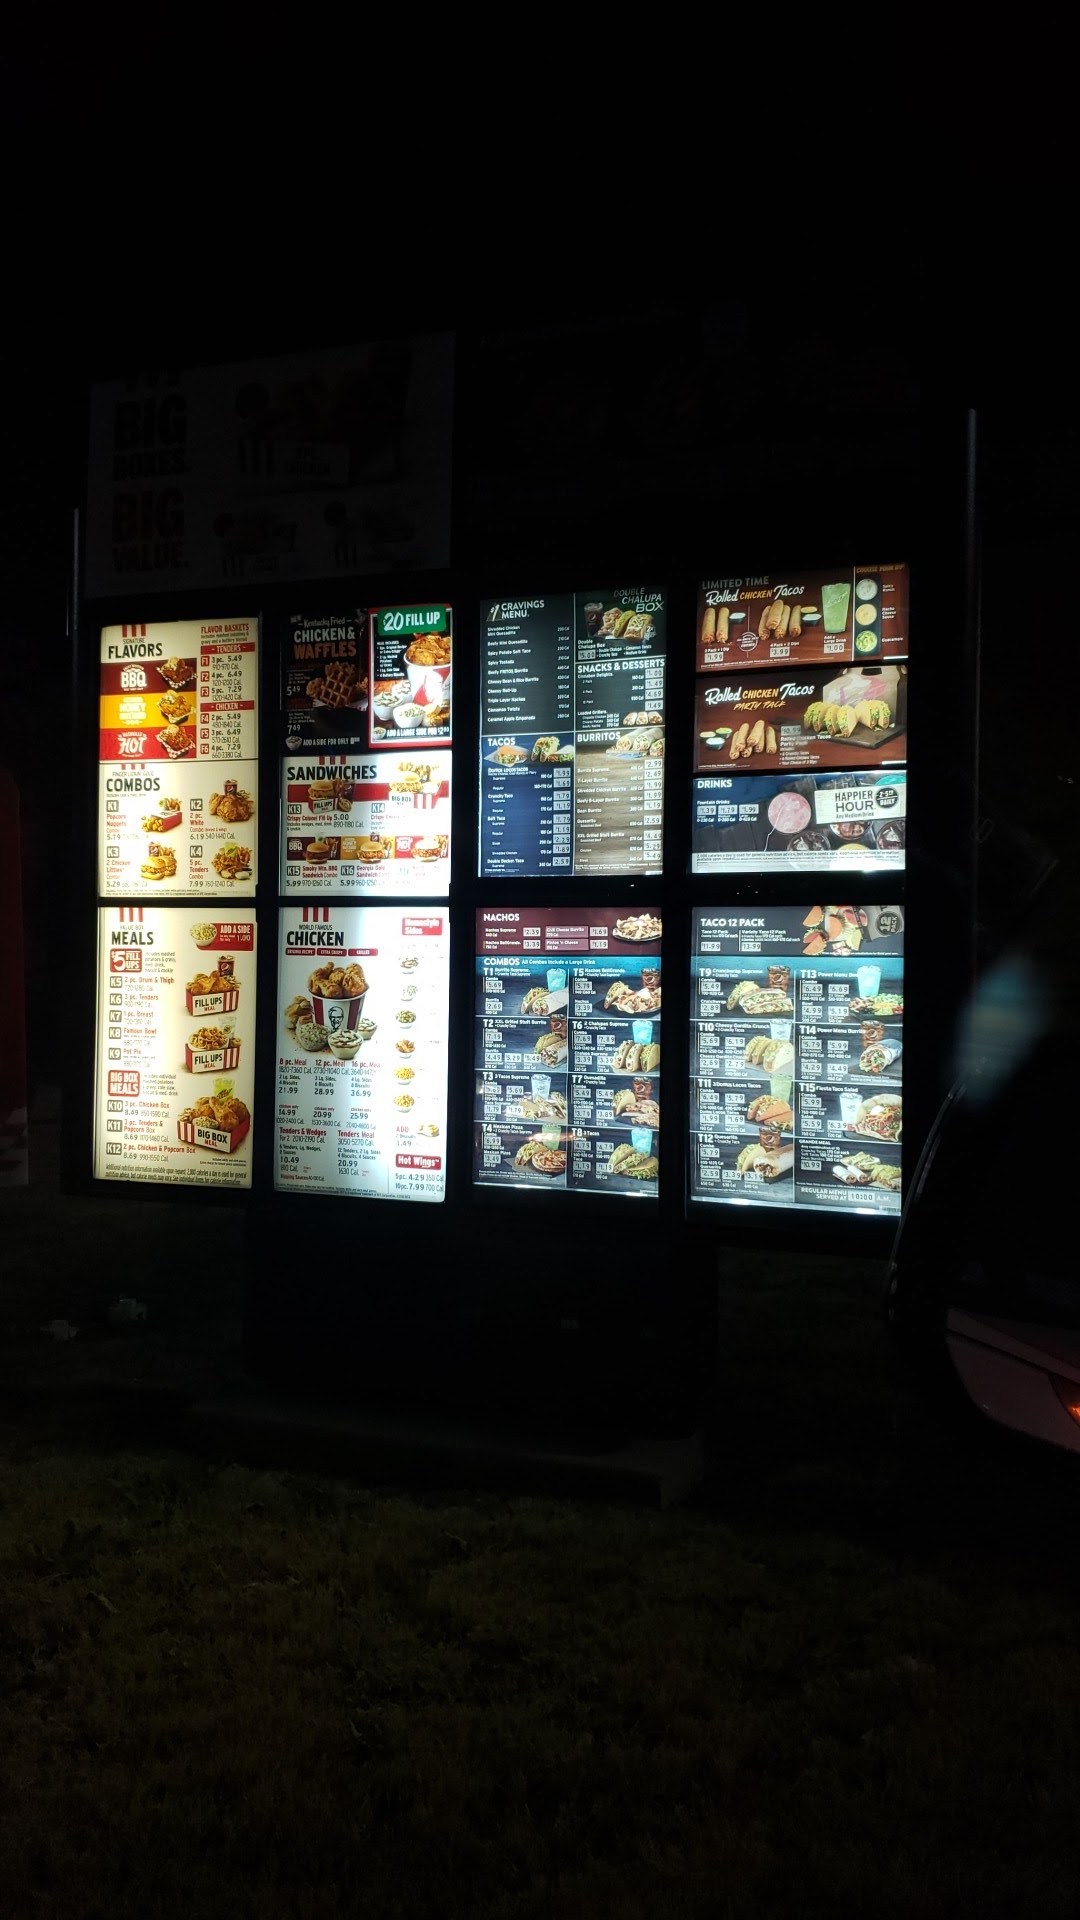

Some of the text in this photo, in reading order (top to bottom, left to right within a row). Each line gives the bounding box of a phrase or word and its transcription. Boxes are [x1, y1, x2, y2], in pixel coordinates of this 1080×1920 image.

[112, 393, 189, 452] BIG
[701, 576, 770, 590] LIMITED TIME
[613, 588, 645, 598] DOUBLE
[705, 584, 805, 606] Rolled CHICKEN Tacos
[621, 593, 662, 605] CHALUPA
[501, 600, 545, 611] CRAVINGS
[635, 601, 664, 613] BOX
[303, 617, 345, 629] Kentucky Fried
[405, 613, 424, 627] FILL
[428, 611, 441, 625] UP
[201, 623, 249, 634] FLAVOR BASKETS
[294, 626, 356, 643] CHICKEN &
[108, 643, 163, 659] FLAVORS
[293, 643, 357, 660] WAFFLES
[578, 664, 612, 673] SNACKS
[622, 658, 665, 670] DESSERTS
[120, 671, 148, 688] BBQ
[704, 682, 815, 705] Rolled CHICKEN Tacos
[733, 702, 760, 711] PARTY
[201, 715, 208, 723] F4
[488, 738, 516, 747] TACOS
[577, 731, 621, 743] BURRITOS
[287, 765, 378, 781] SANDWICHES
[106, 777, 161, 792] COMBOS
[697, 779, 732, 789] DRINKS
[834, 790, 873, 802] HAPPIER
[191, 800, 202, 810] K2
[289, 805, 300, 813] K13
[191, 847, 202, 856] K4
[239, 925, 250, 933] SIDE
[890, 916, 898, 933] PACK
[111, 931, 154, 945] MEALS
[286, 931, 345, 946] CHICKEN
[126, 961, 139, 970] UPS
[573, 969, 584, 977] T5
[699, 968, 711, 977] T9
[800, 970, 816, 979] T13
[195, 997, 222, 1008] FILL UPS
[698, 1023, 714, 1032] T10
[800, 1026, 816, 1035] T14
[195, 1055, 209, 1064] FILL
[110, 1073, 138, 1083] BIG BOX
[572, 1075, 582, 1083] T7
[698, 1079, 711, 1088] T11
[110, 1083, 138, 1094] MEALS
[799, 1083, 815, 1093] T15
[306, 1128, 326, 1136] Wedges
[482, 1124, 492, 1132] T4
[572, 1128, 582, 1137] T8
[197, 1129, 228, 1144] BIG BOX
[698, 1134, 713, 1143] T12
